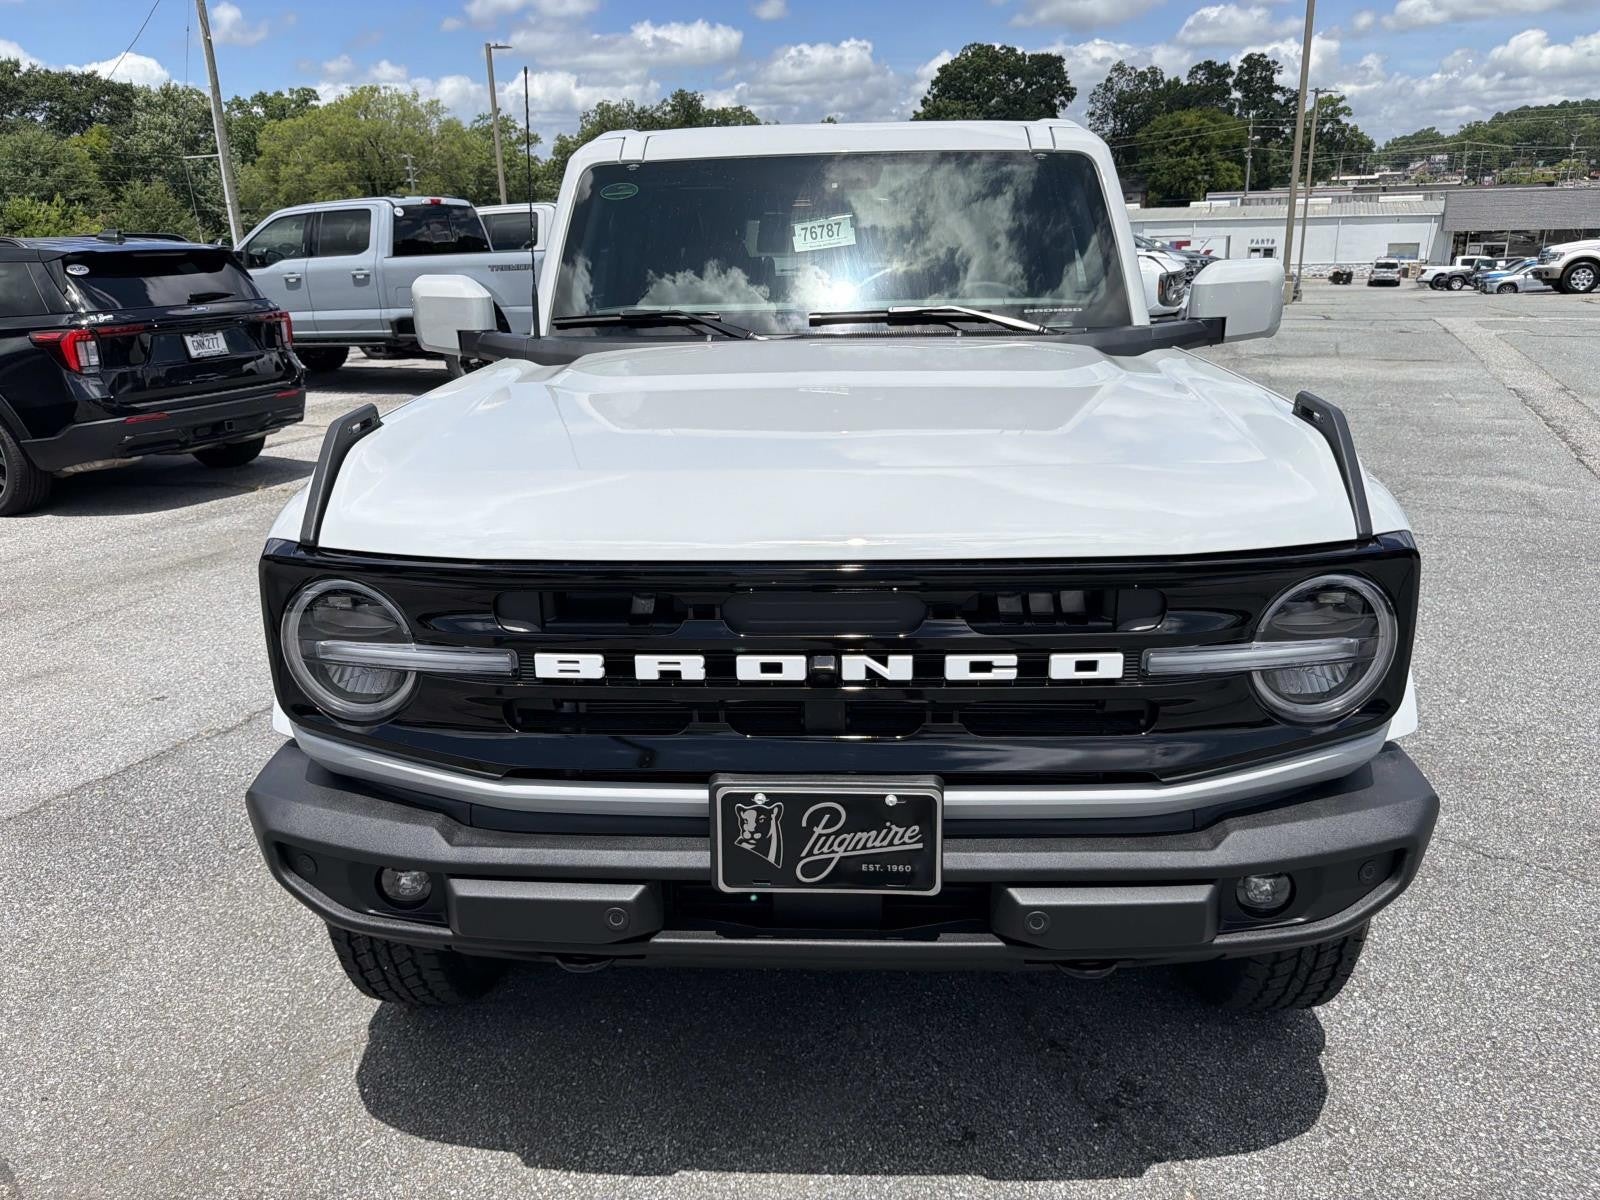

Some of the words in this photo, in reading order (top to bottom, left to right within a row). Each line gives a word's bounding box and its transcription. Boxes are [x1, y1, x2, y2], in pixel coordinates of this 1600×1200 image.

[800, 222, 842, 242] 76787
[191, 337, 220, 351] GNK277
[534, 652, 1124, 682] BRONCO
[796, 801, 923, 883] Pugmire
[861, 864, 883, 872] EST.
